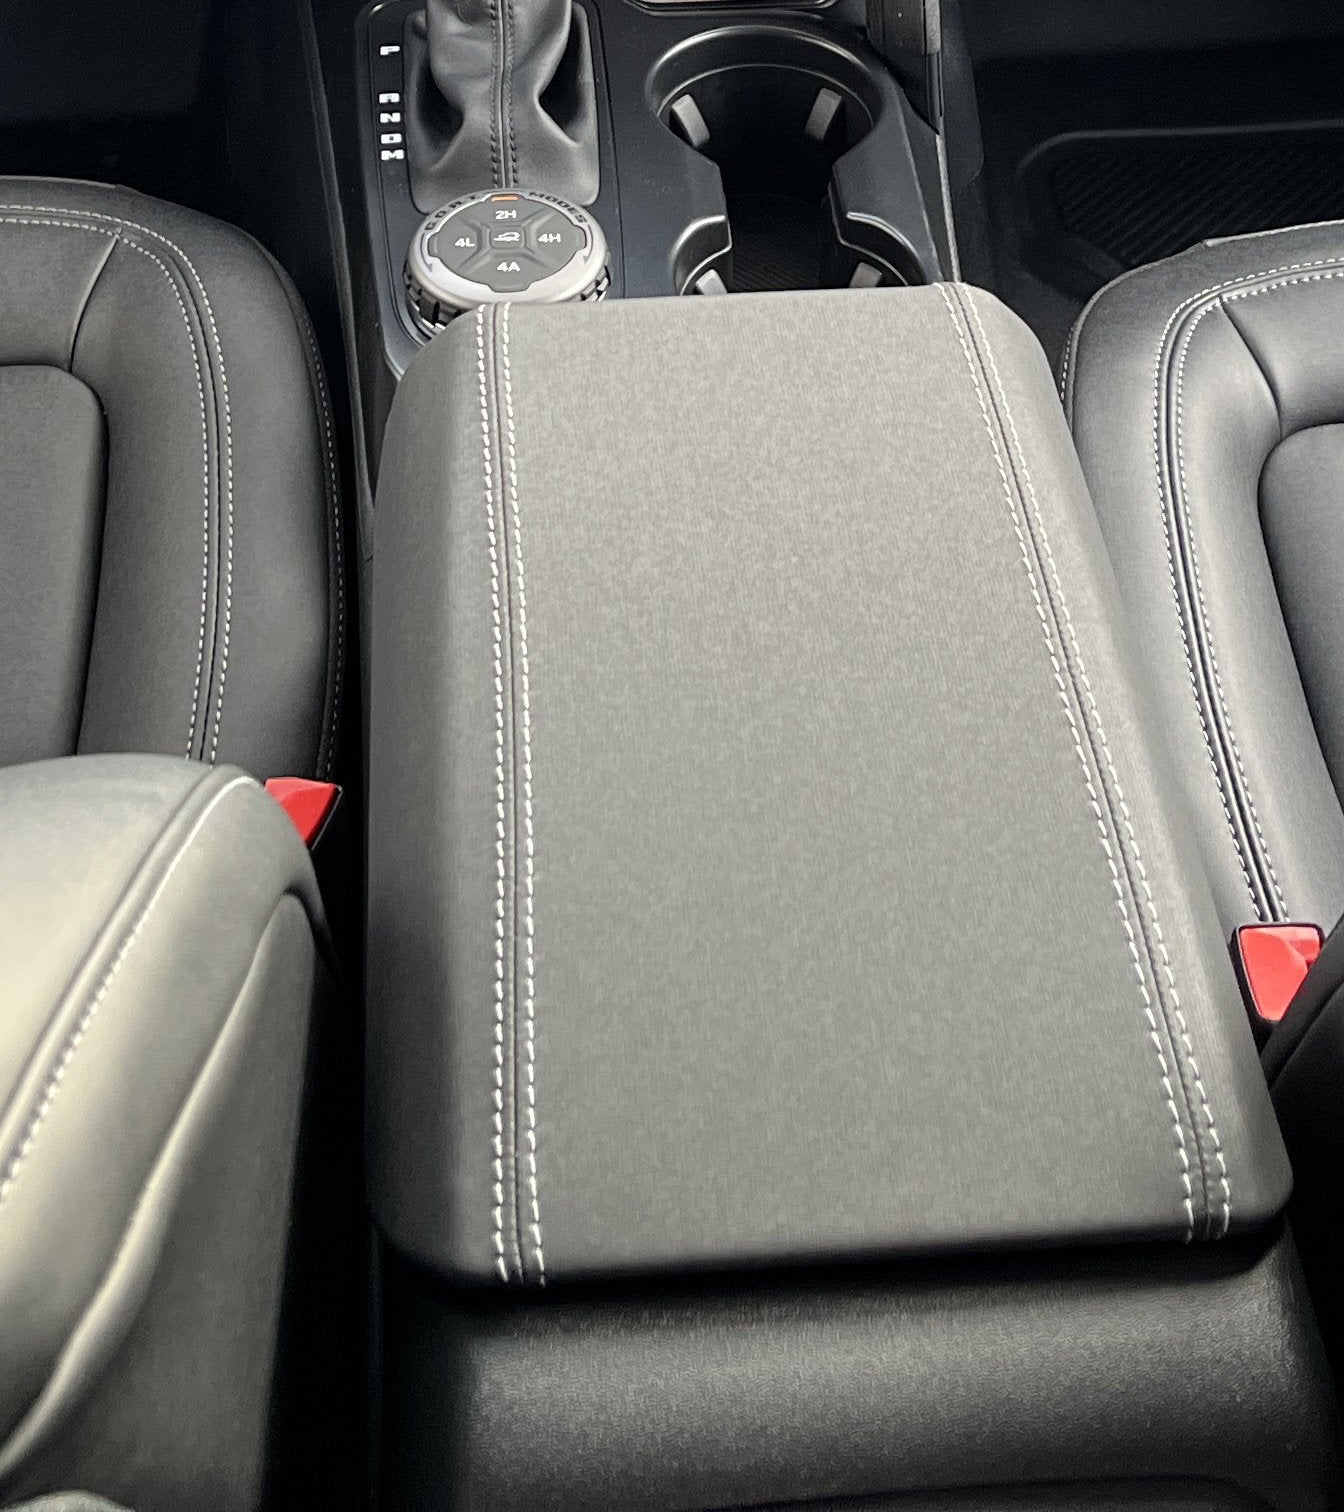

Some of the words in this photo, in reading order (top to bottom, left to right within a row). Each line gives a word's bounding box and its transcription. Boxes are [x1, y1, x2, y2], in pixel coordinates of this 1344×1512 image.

[379, 45, 400, 56] P
[378, 93, 400, 104] R
[379, 112, 401, 123] N
[380, 133, 402, 144] D
[380, 149, 405, 161] M
[528, 191, 588, 224] MODES
[495, 209, 517, 220] 2H
[454, 238, 477, 248] 4L
[537, 233, 562, 243] 4H
[496, 261, 521, 272] 4A
